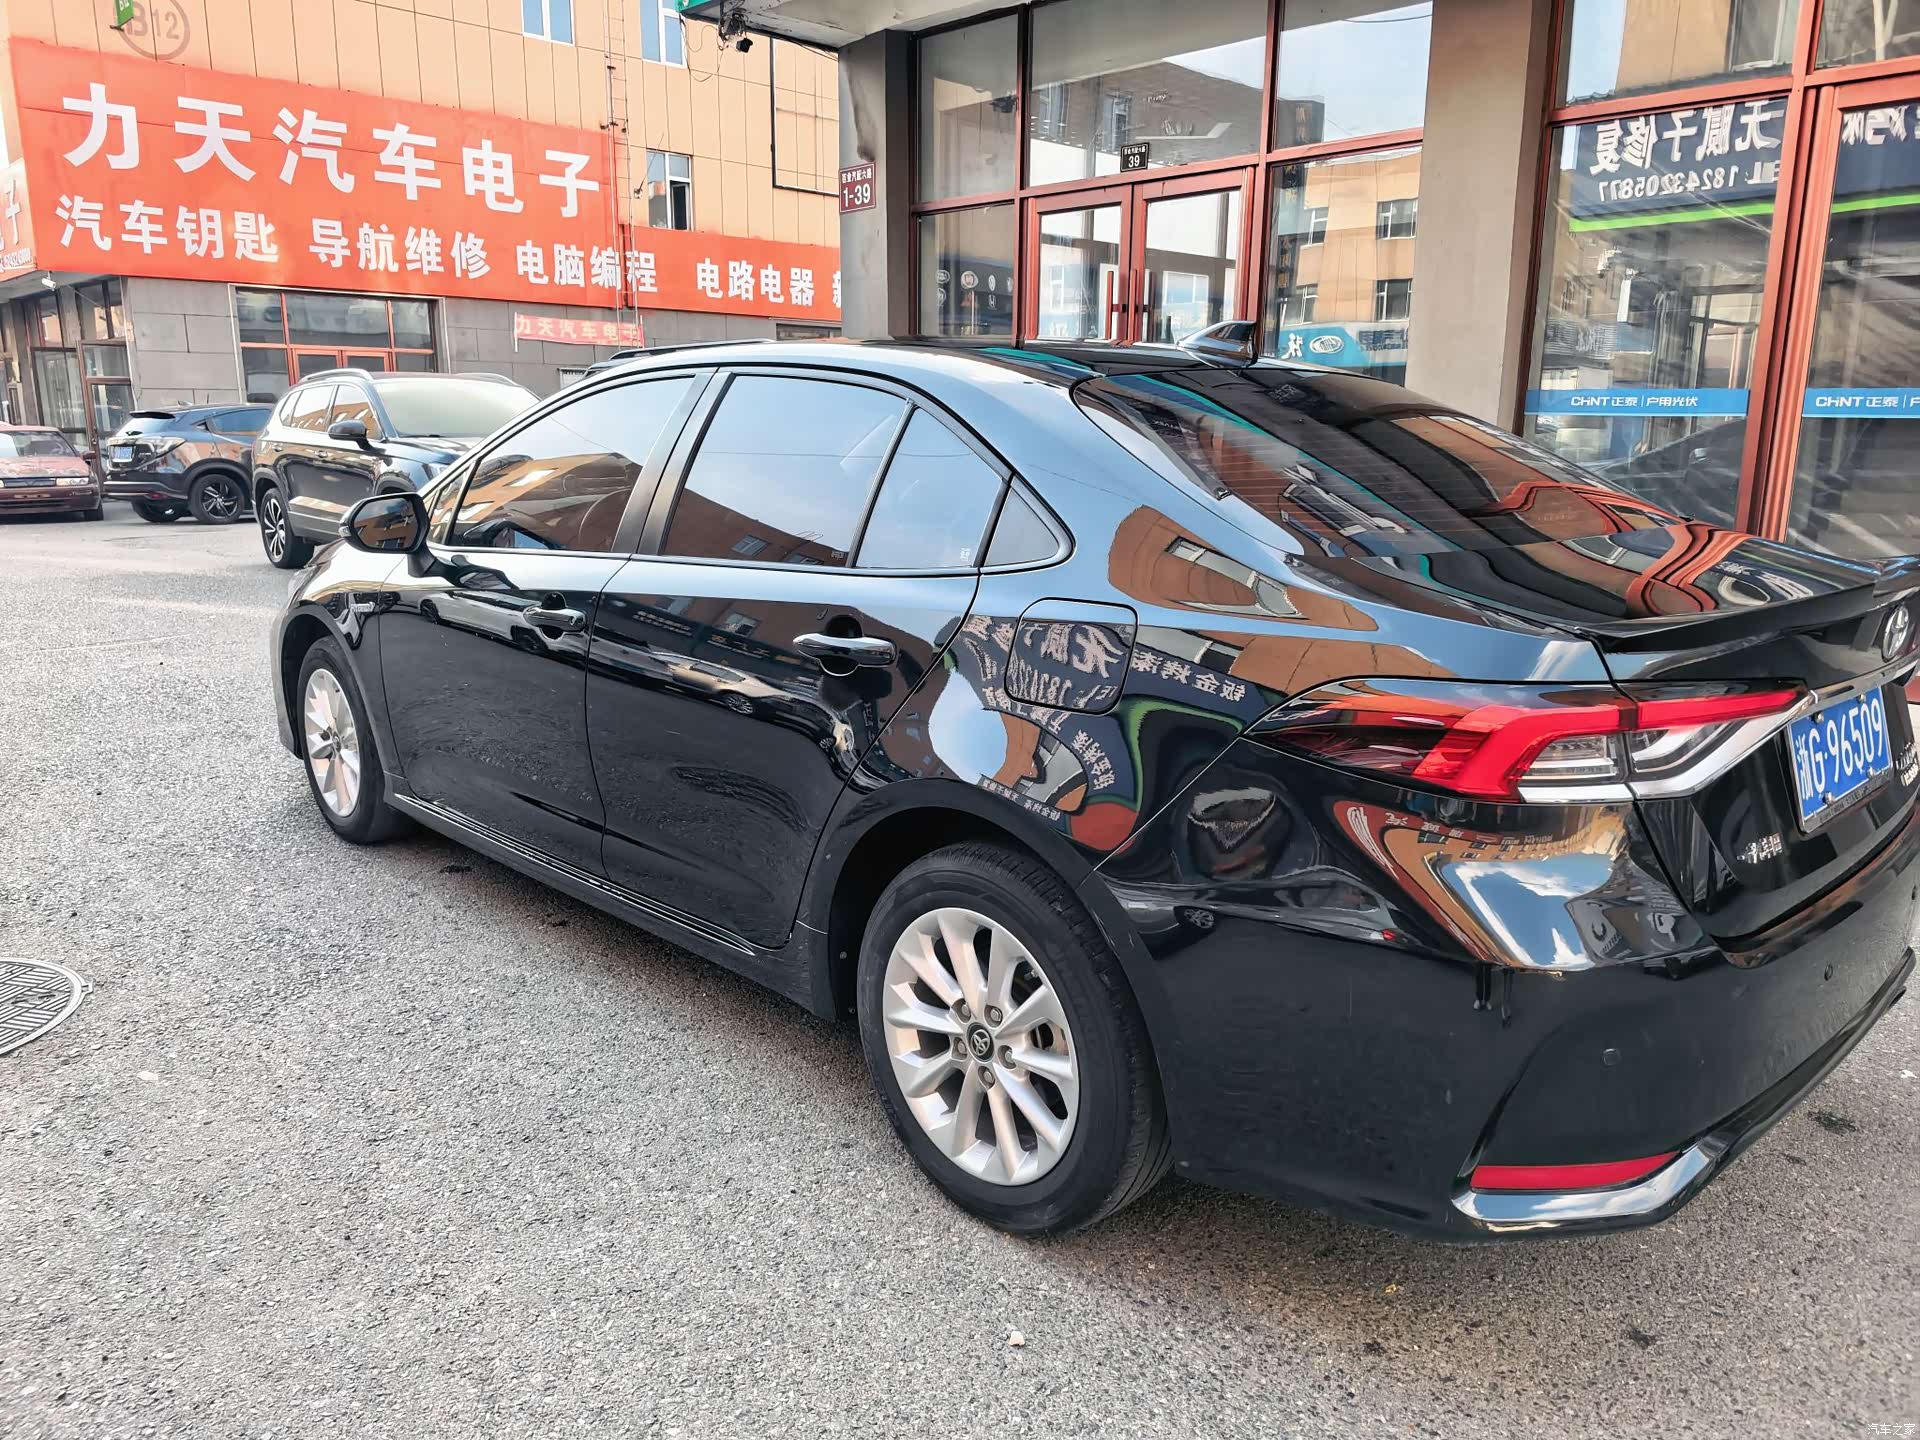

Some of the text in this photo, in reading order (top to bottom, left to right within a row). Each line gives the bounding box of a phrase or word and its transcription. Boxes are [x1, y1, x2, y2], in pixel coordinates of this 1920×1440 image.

[62, 82, 599, 218] 力天汽车电子
[1128, 155, 1140, 168] 39
[843, 183, 871, 208] 1-39
[55, 194, 279, 263] 汽车钥匙
[309, 217, 490, 279] 导航维修
[516, 237, 658, 293] 电脑编程
[696, 257, 815, 306] 电路电器
[1646, 396, 1698, 407] 户用光伏
